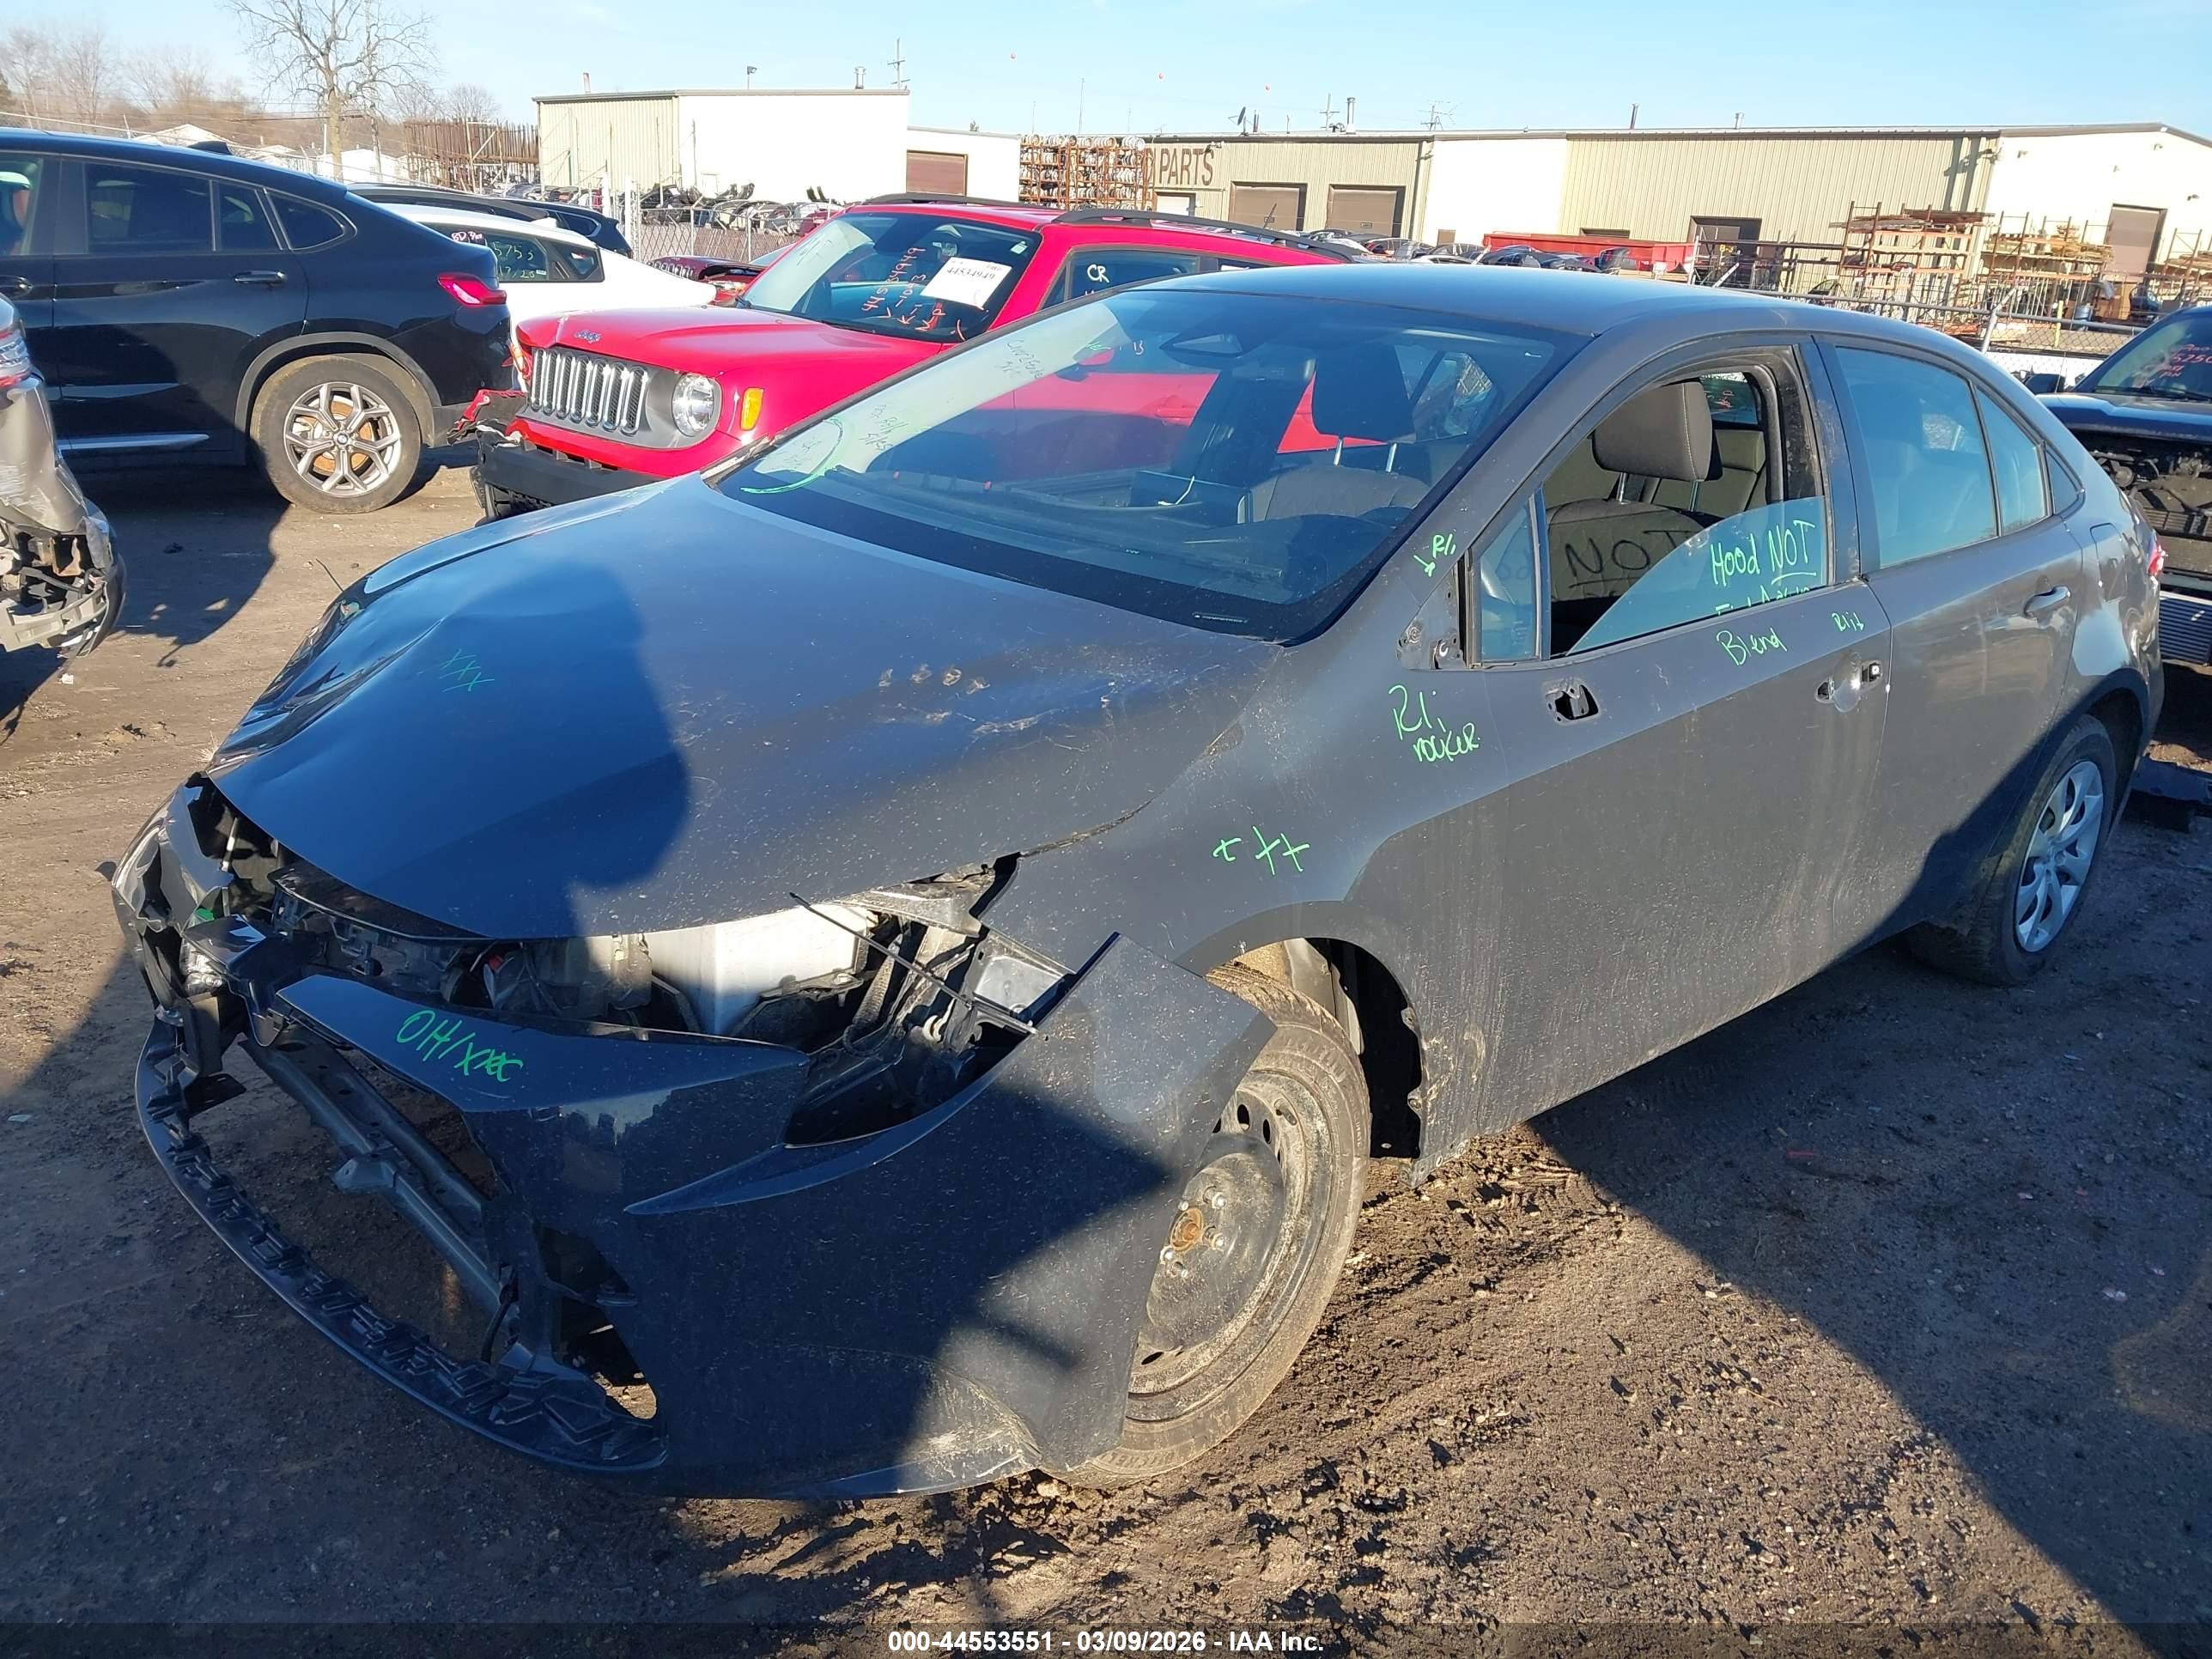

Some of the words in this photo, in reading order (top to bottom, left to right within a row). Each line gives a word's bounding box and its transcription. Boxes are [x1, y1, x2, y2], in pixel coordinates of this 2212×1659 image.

[1158, 148, 1214, 185] PARTS
[1086, 264, 1109, 283] CR
[1711, 533, 1760, 587] Hood
[1768, 520, 1816, 573] NOT
[1716, 628, 1788, 666] Blend
